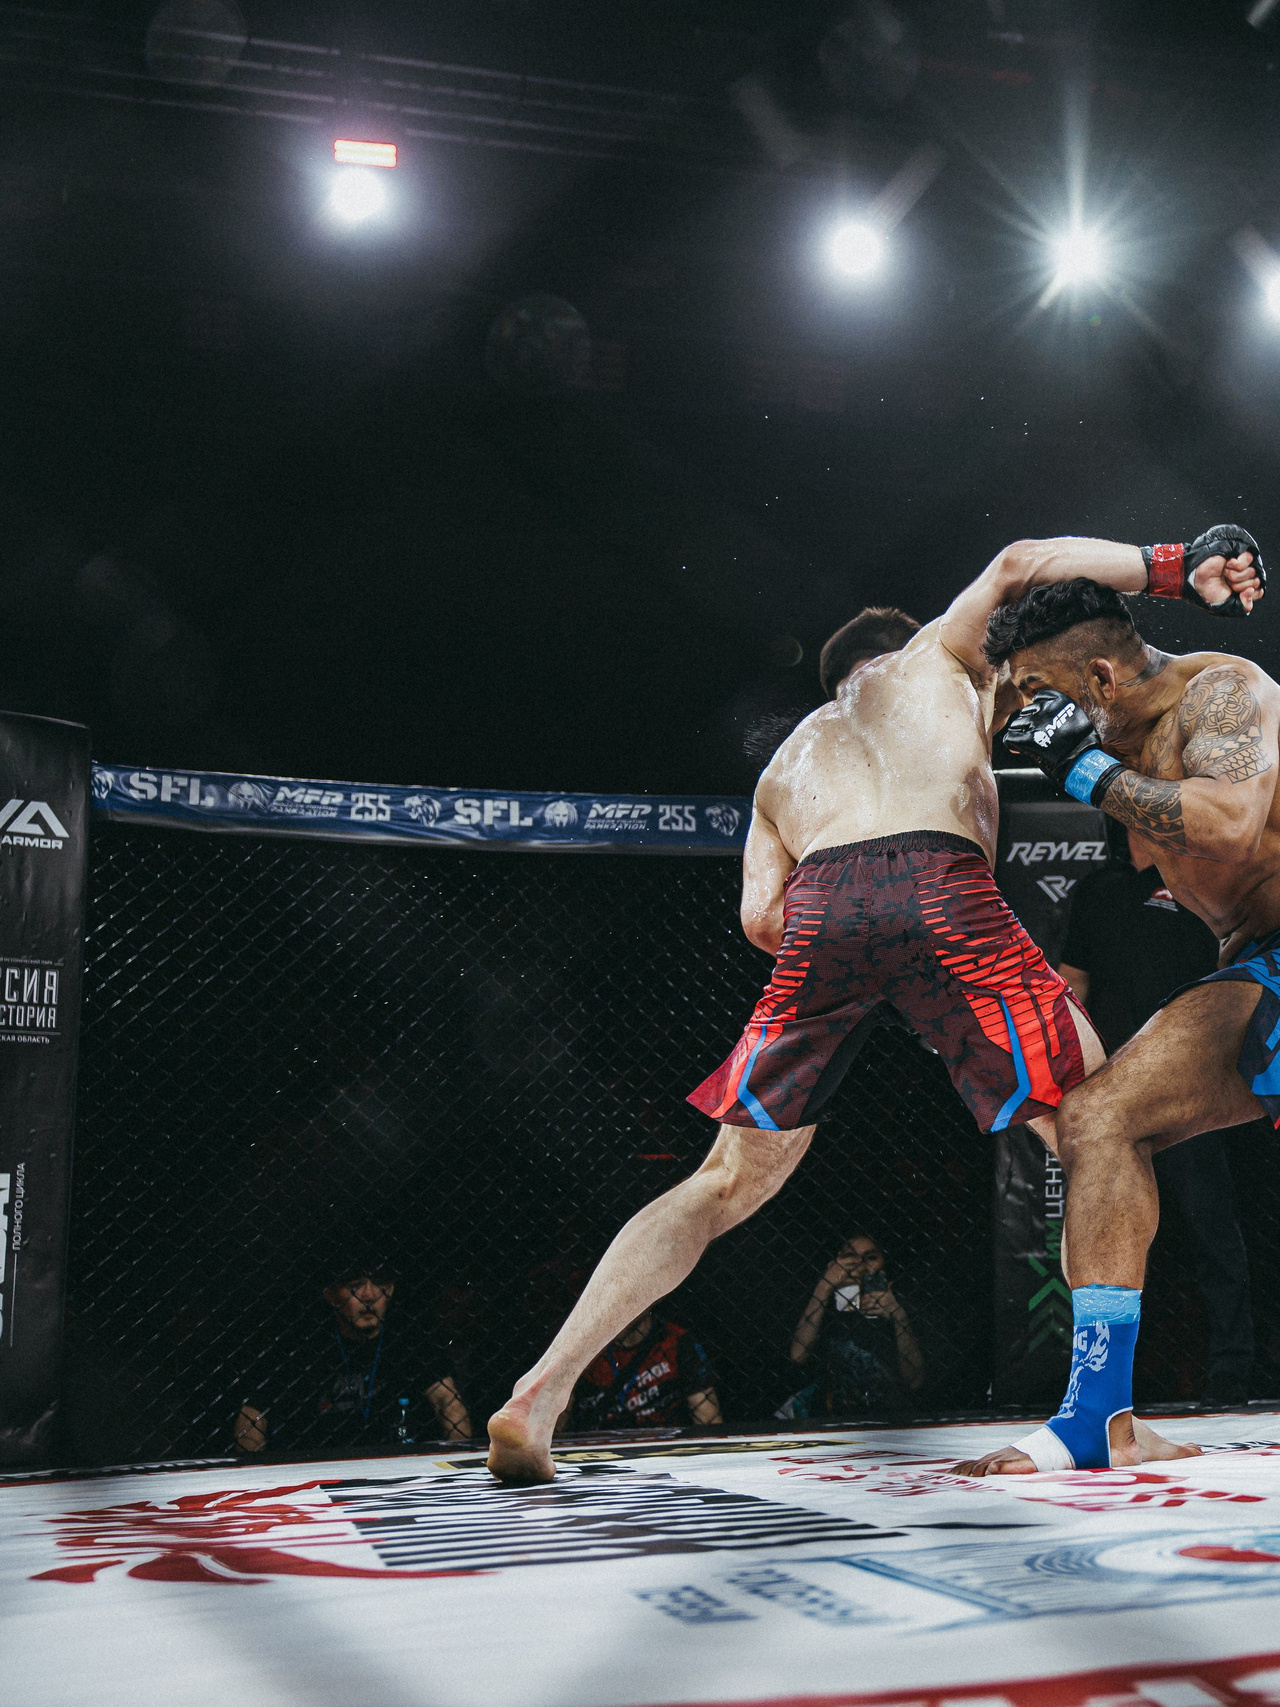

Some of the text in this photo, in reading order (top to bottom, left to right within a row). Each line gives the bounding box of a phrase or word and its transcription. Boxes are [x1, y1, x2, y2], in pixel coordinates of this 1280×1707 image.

[1046, 702, 1076, 738] MFP
[129, 772, 391, 822] SFL MFP 255
[453, 798, 697, 832] SFL MFP 255
[1, 834, 63, 850] ARMOR
[0, 966, 59, 1005] СИЯ
[0, 1034, 50, 1045] КАЯ ОБЛАСТЬ
[12, 1162, 26, 1251] ПОЛНОГО ЦИКЛА
